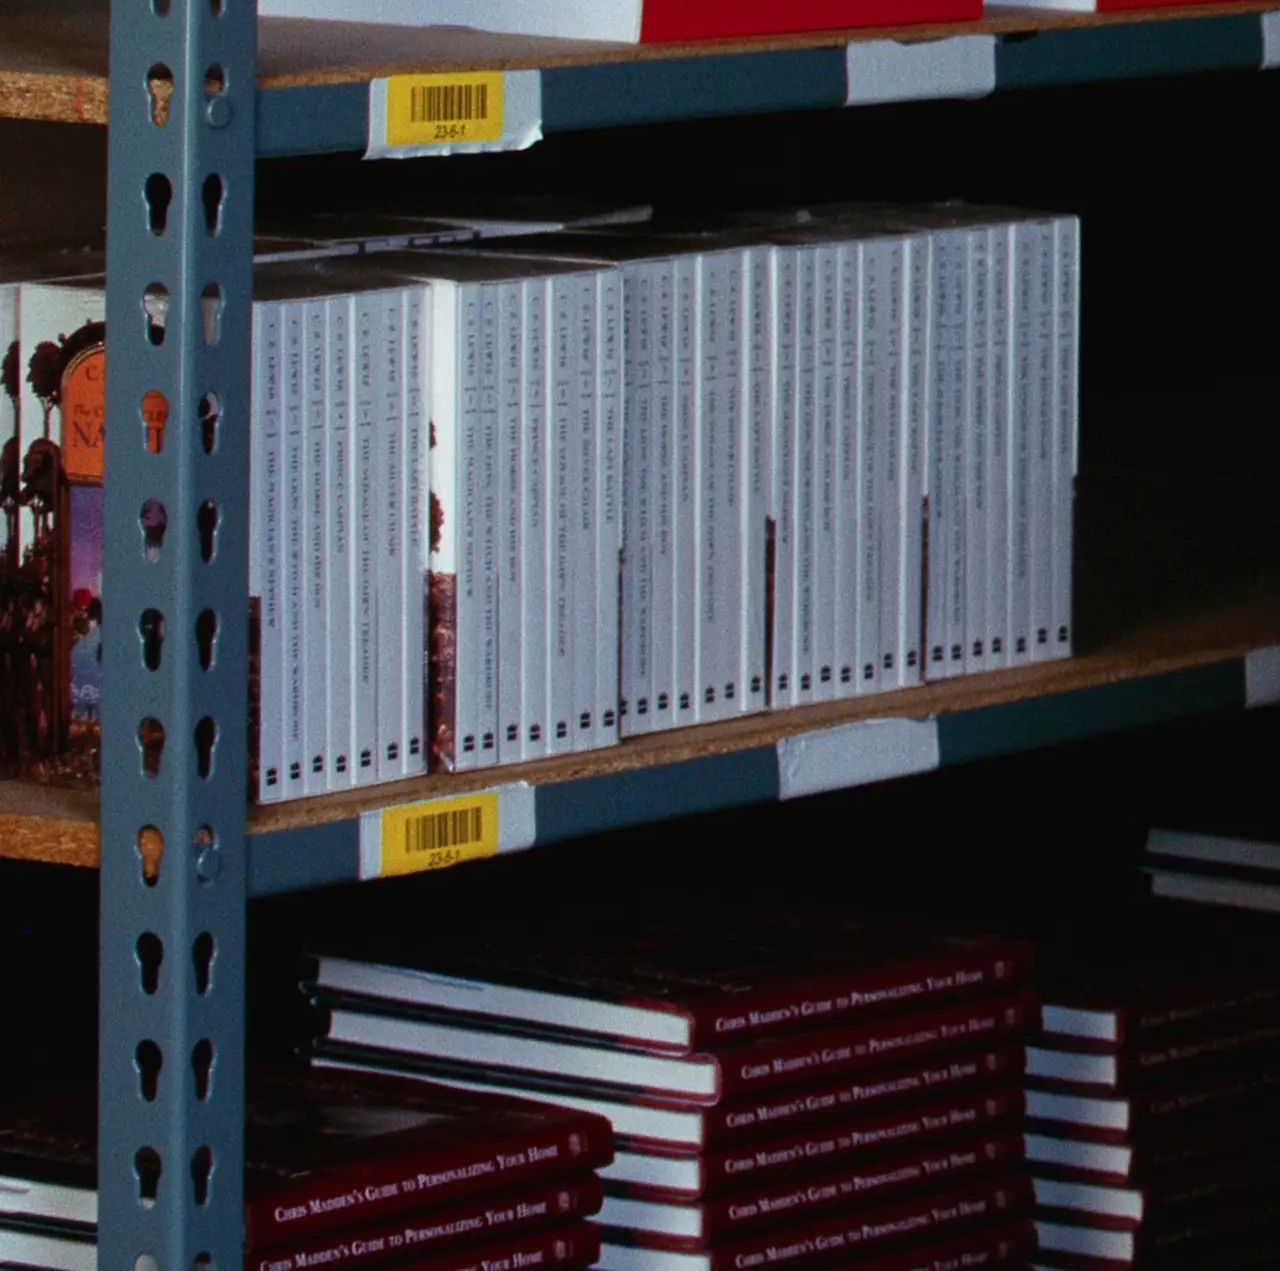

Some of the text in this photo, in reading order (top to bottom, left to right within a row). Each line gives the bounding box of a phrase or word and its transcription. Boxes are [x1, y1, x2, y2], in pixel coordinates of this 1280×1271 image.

[274, 1204, 308, 1223] CHRIS
[364, 1182, 400, 1202] GUIDE
[401, 1179, 416, 1193] TO
[417, 1160, 495, 1190] PERSONALIZING
[496, 1152, 526, 1170] YOUR
[527, 1144, 559, 1163] HOME
[351, 1237, 385, 1256] GUIDE
[388, 1234, 404, 1248] TO
[404, 1216, 483, 1244] PERSONALIZING
[484, 1208, 514, 1226] YOUR
[516, 1200, 547, 1220] HOME
